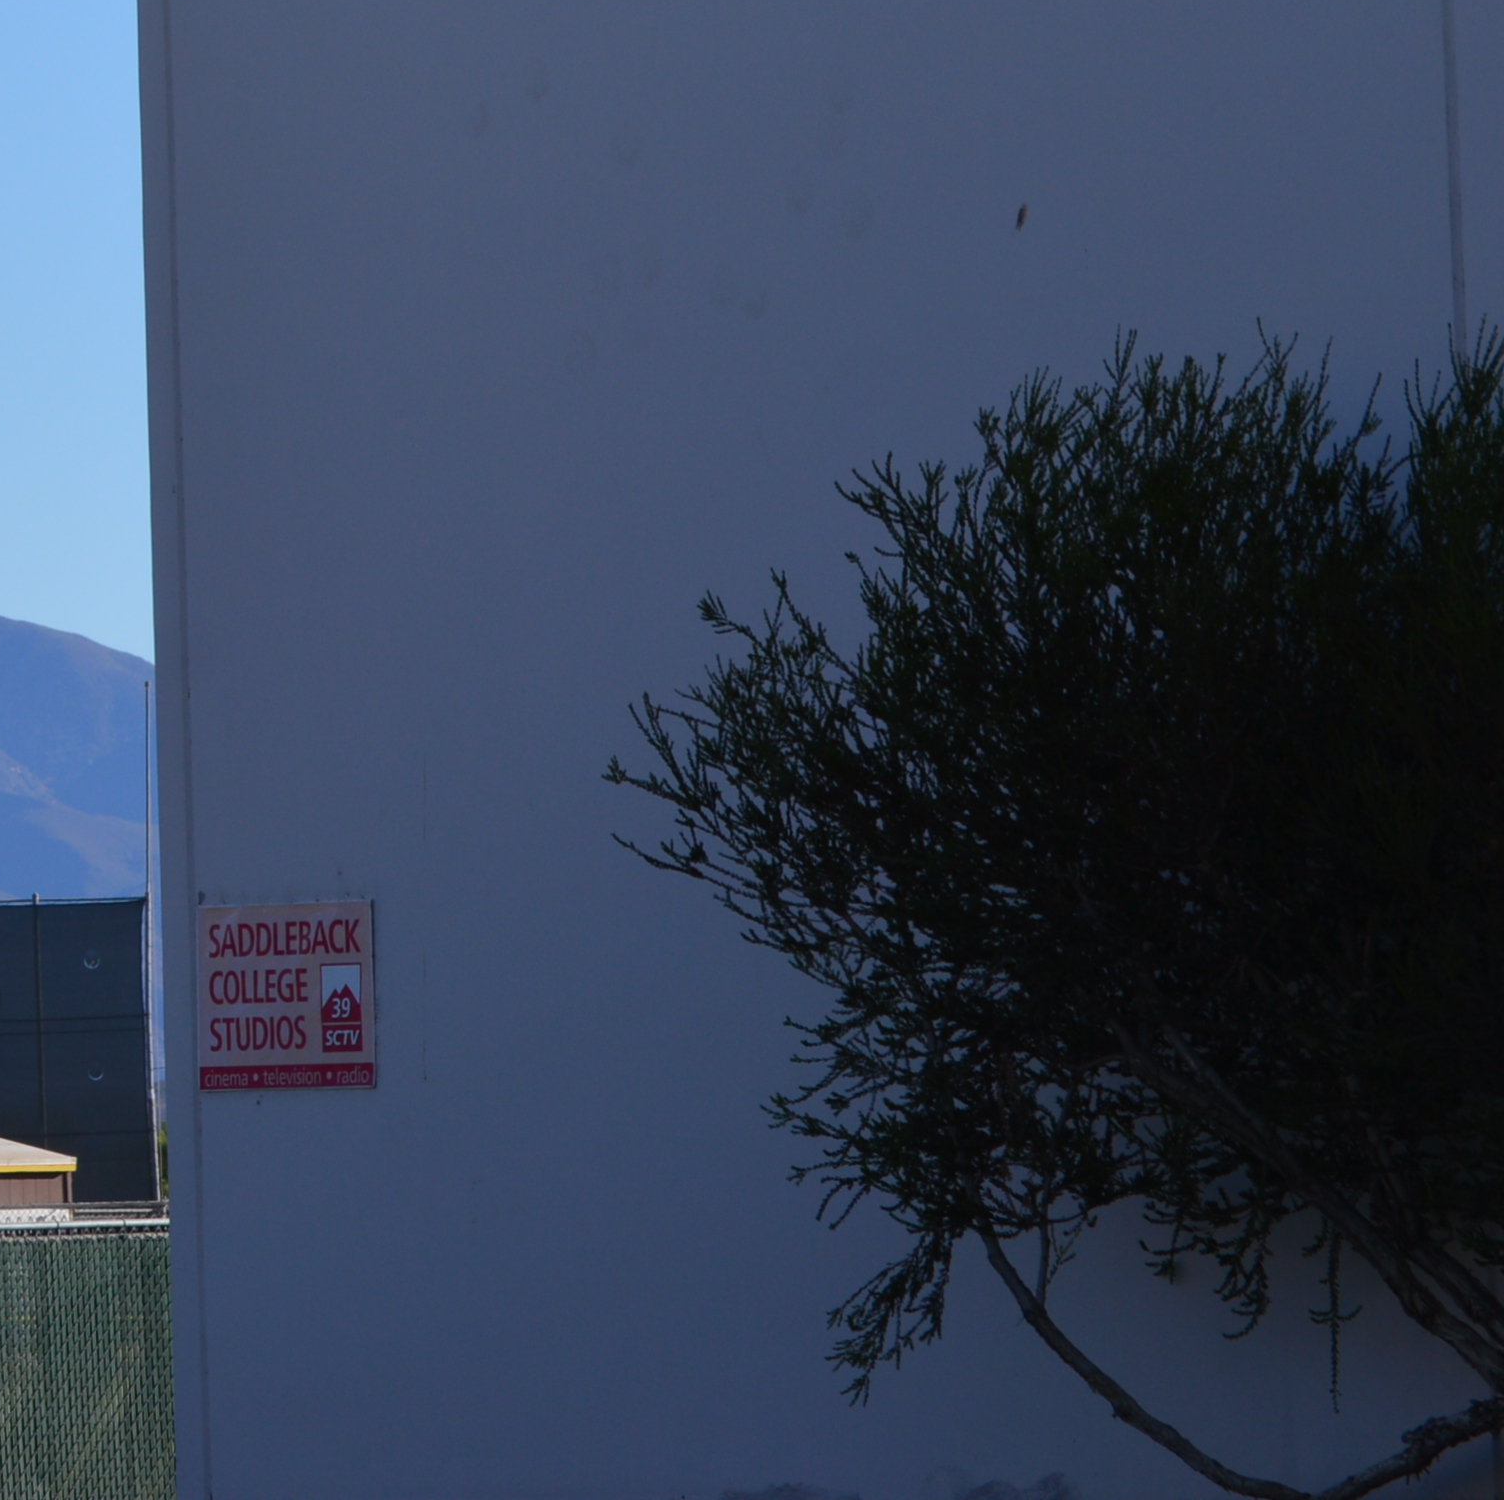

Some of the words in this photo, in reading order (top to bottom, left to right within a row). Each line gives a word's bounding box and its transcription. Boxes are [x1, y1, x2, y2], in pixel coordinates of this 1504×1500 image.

[209, 918, 361, 958] SADDLEBACK
[209, 968, 308, 1005] COLLEGE
[331, 997, 351, 1018] 39
[209, 1015, 307, 1052] STUDIOS
[325, 1029, 360, 1046] SCTV
[205, 1069, 249, 1087] cinema
[262, 1067, 322, 1086] television
[336, 1066, 370, 1083] radio
